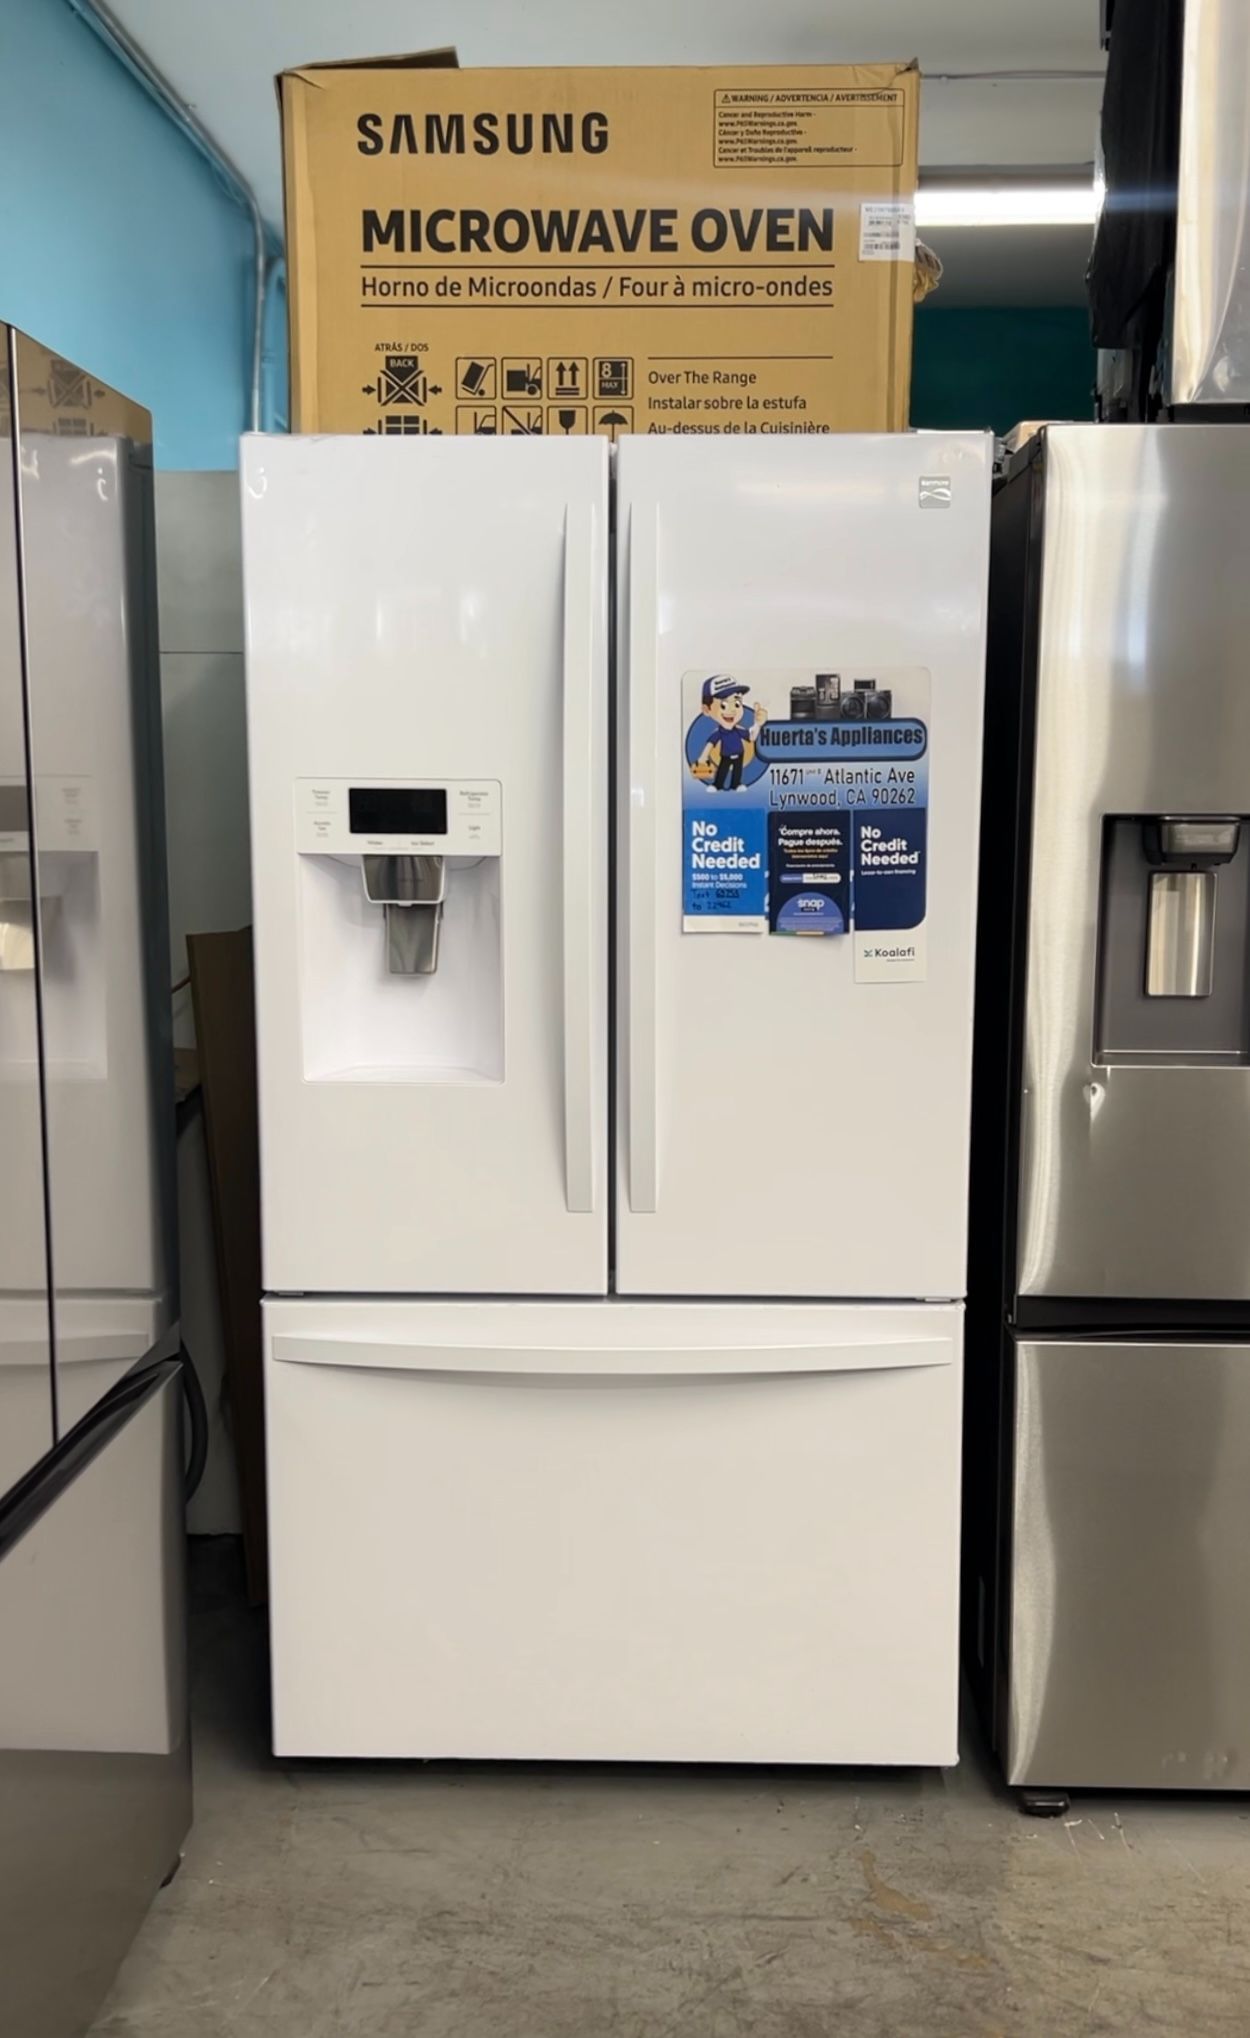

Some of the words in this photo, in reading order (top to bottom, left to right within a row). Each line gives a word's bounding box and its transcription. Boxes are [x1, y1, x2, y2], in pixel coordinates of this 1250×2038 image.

[730, 94, 769, 103] WARNING
[775, 93, 829, 102] ADVERTENCIA
[357, 112, 608, 155] SAMSUNG
[362, 207, 679, 254] MICROWAVE
[691, 207, 834, 253] OVEN
[361, 276, 430, 297] Horno
[434, 275, 463, 297] de
[468, 275, 597, 298] Microondas
[619, 276, 669, 297] Four
[673, 275, 685, 297] à
[692, 275, 833, 298] micro-ondes
[374, 342, 404, 352] ATRÁS
[410, 342, 430, 353] DOS
[389, 358, 415, 369] BACK
[601, 363, 613, 378] 8
[601, 381, 619, 390] MAX
[647, 371, 682, 385] Over
[684, 370, 710, 385] The
[712, 370, 758, 388] Range
[648, 396, 703, 410] Instalar
[703, 395, 744, 410] sobre
[746, 396, 760, 410] la
[762, 395, 808, 410] estufa
[647, 421, 721, 435] Au-dessus
[723, 421, 742, 435] de
[743, 421, 758, 435] la
[760, 420, 831, 435] Cuisinière
[759, 727, 828, 747] Huerta's
[830, 725, 924, 747] Appliances
[770, 768, 805, 785] 11671
[823, 768, 883, 785] Atlantic
[887, 767, 916, 784] Ave
[769, 790, 841, 810] Lynwood,
[846, 788, 866, 805] CA
[872, 787, 916, 805] 90262
[692, 820, 718, 837] No
[780, 827, 813, 838] Compre
[860, 825, 882, 839] No
[692, 836, 745, 853] Credit
[778, 837, 804, 849] Pague
[860, 838, 908, 853] Credit
[692, 853, 761, 870] Needed
[797, 898, 825, 911] snap
[874, 947, 915, 958] Koalafi
